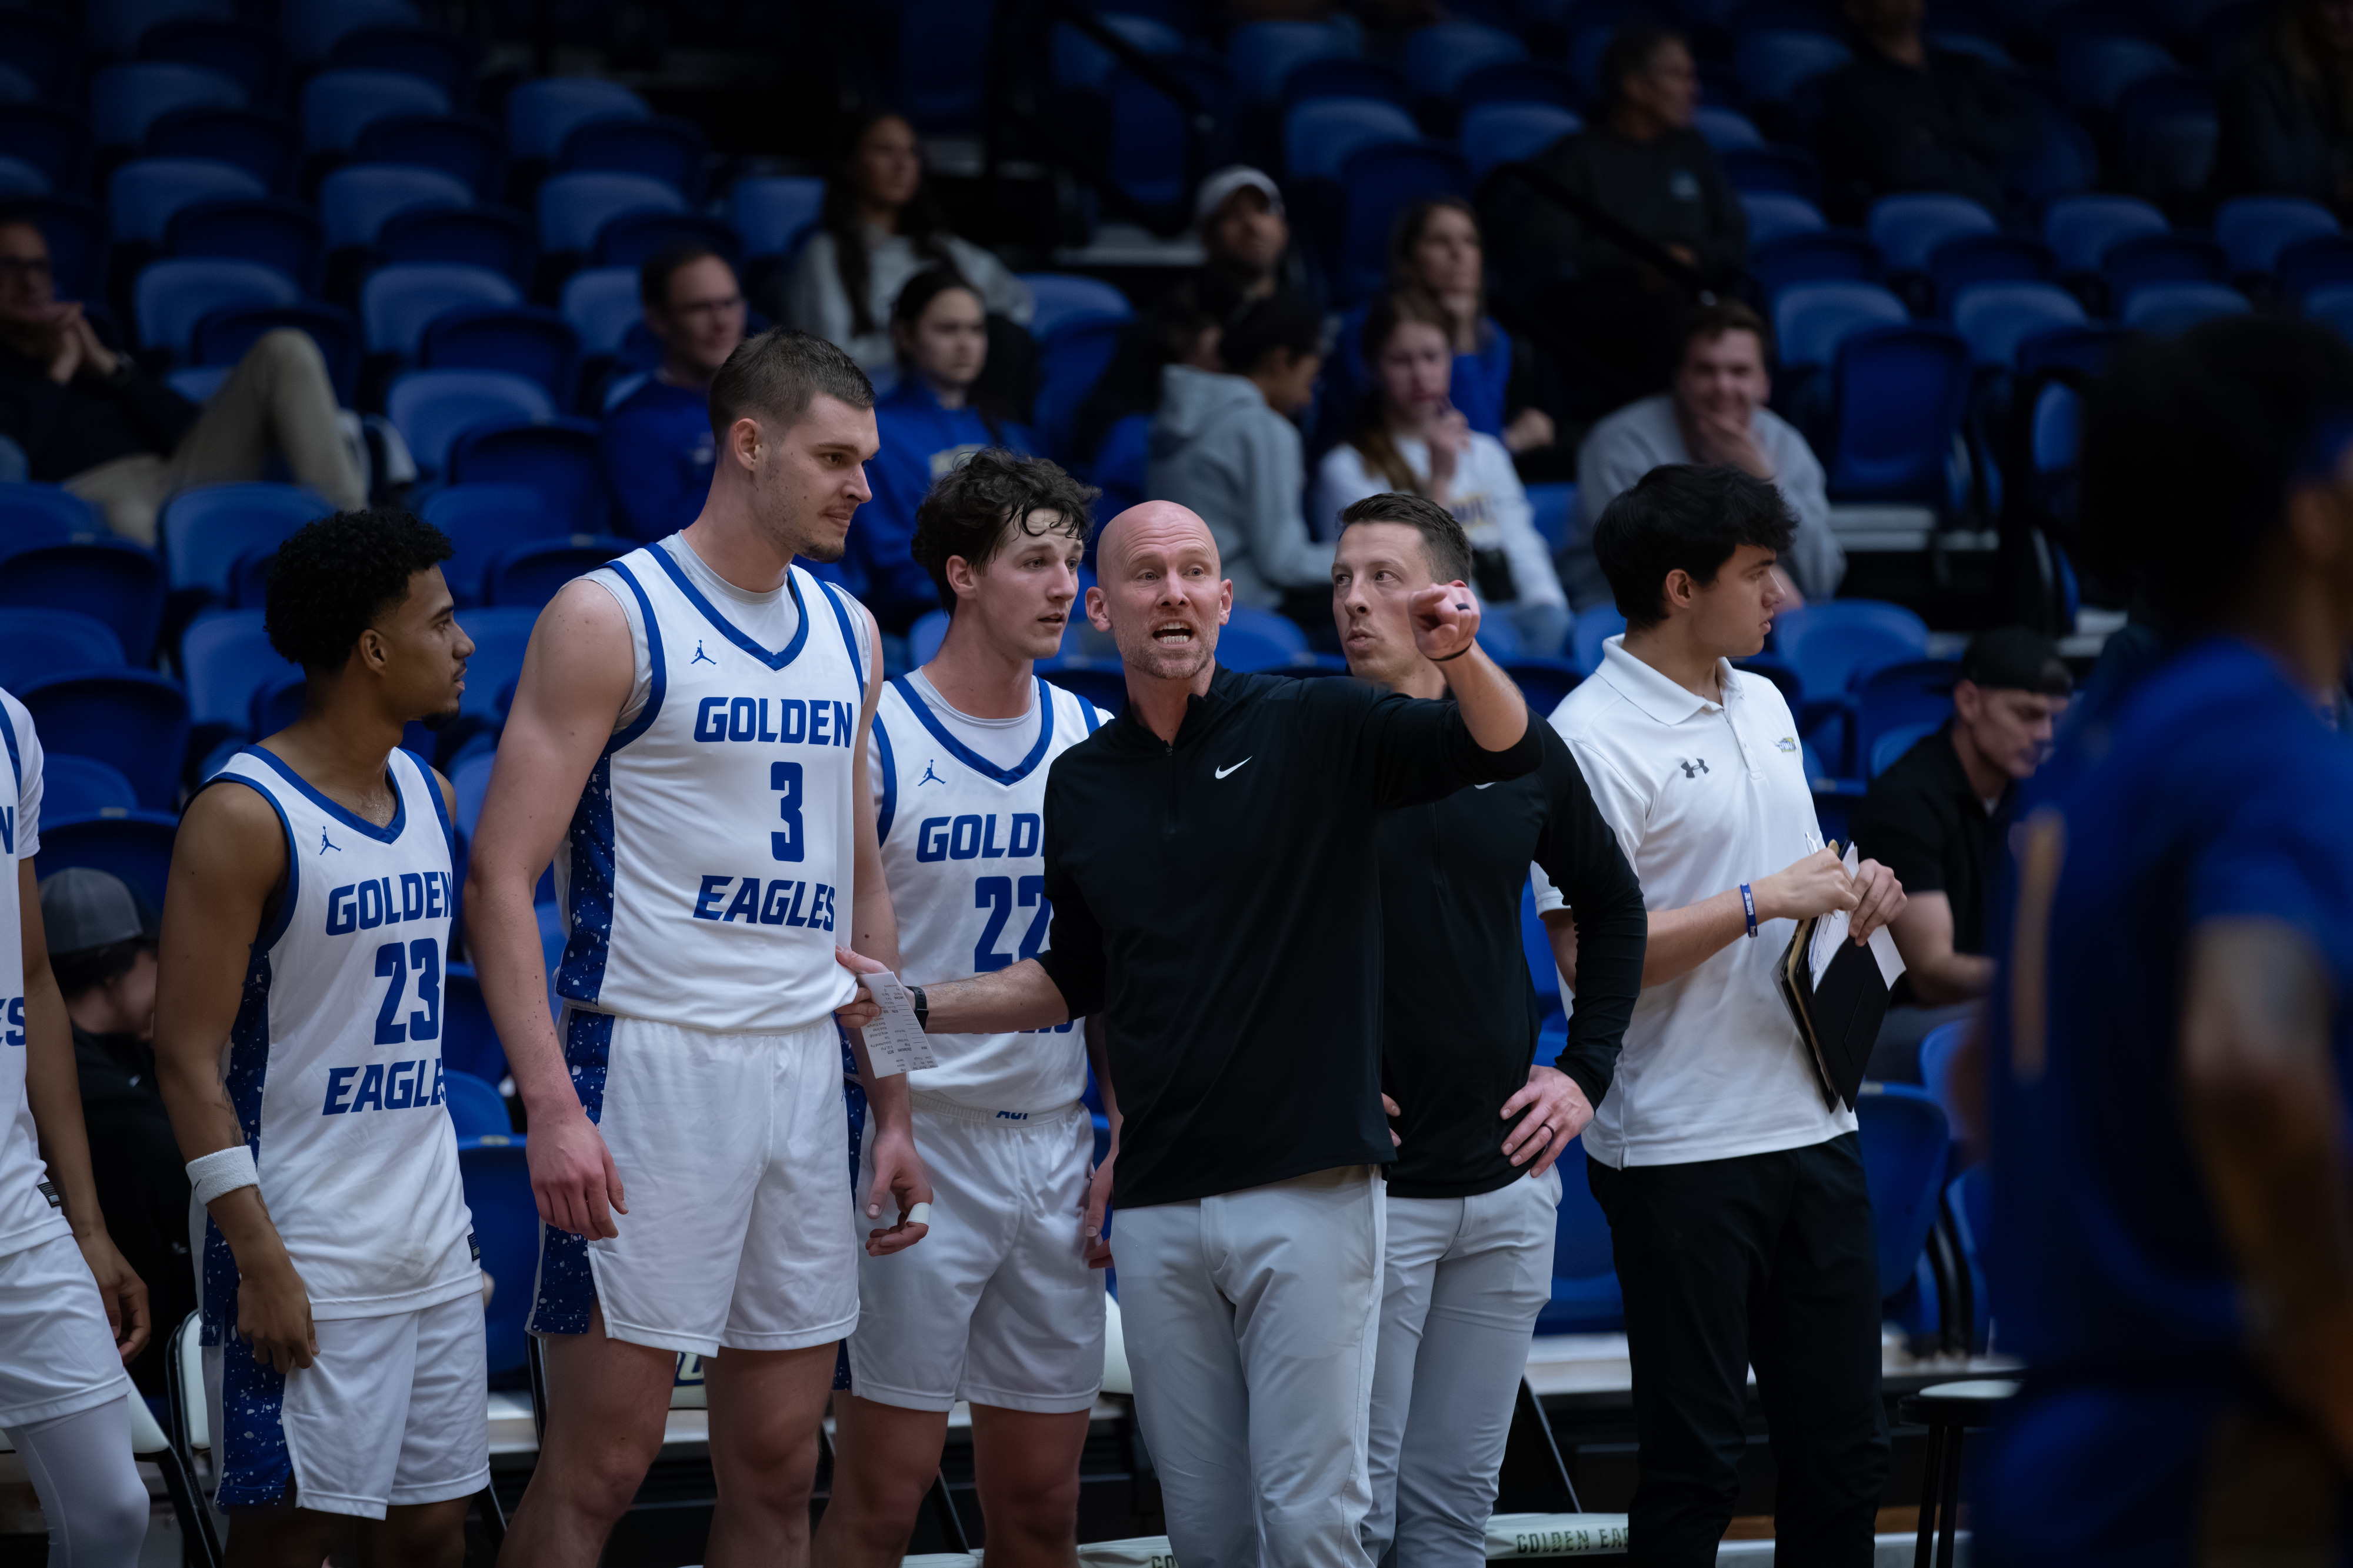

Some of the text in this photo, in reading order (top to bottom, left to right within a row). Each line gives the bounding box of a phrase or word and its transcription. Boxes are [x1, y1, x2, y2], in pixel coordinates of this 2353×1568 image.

[694, 697, 852, 748] GOLDEN
[771, 762, 805, 862] 3
[916, 813, 1045, 862] GOLD
[326, 872, 453, 936] GOLDEN
[693, 875, 835, 932] EAGLES
[974, 875, 1052, 973] 22
[374, 938, 440, 1045] 23
